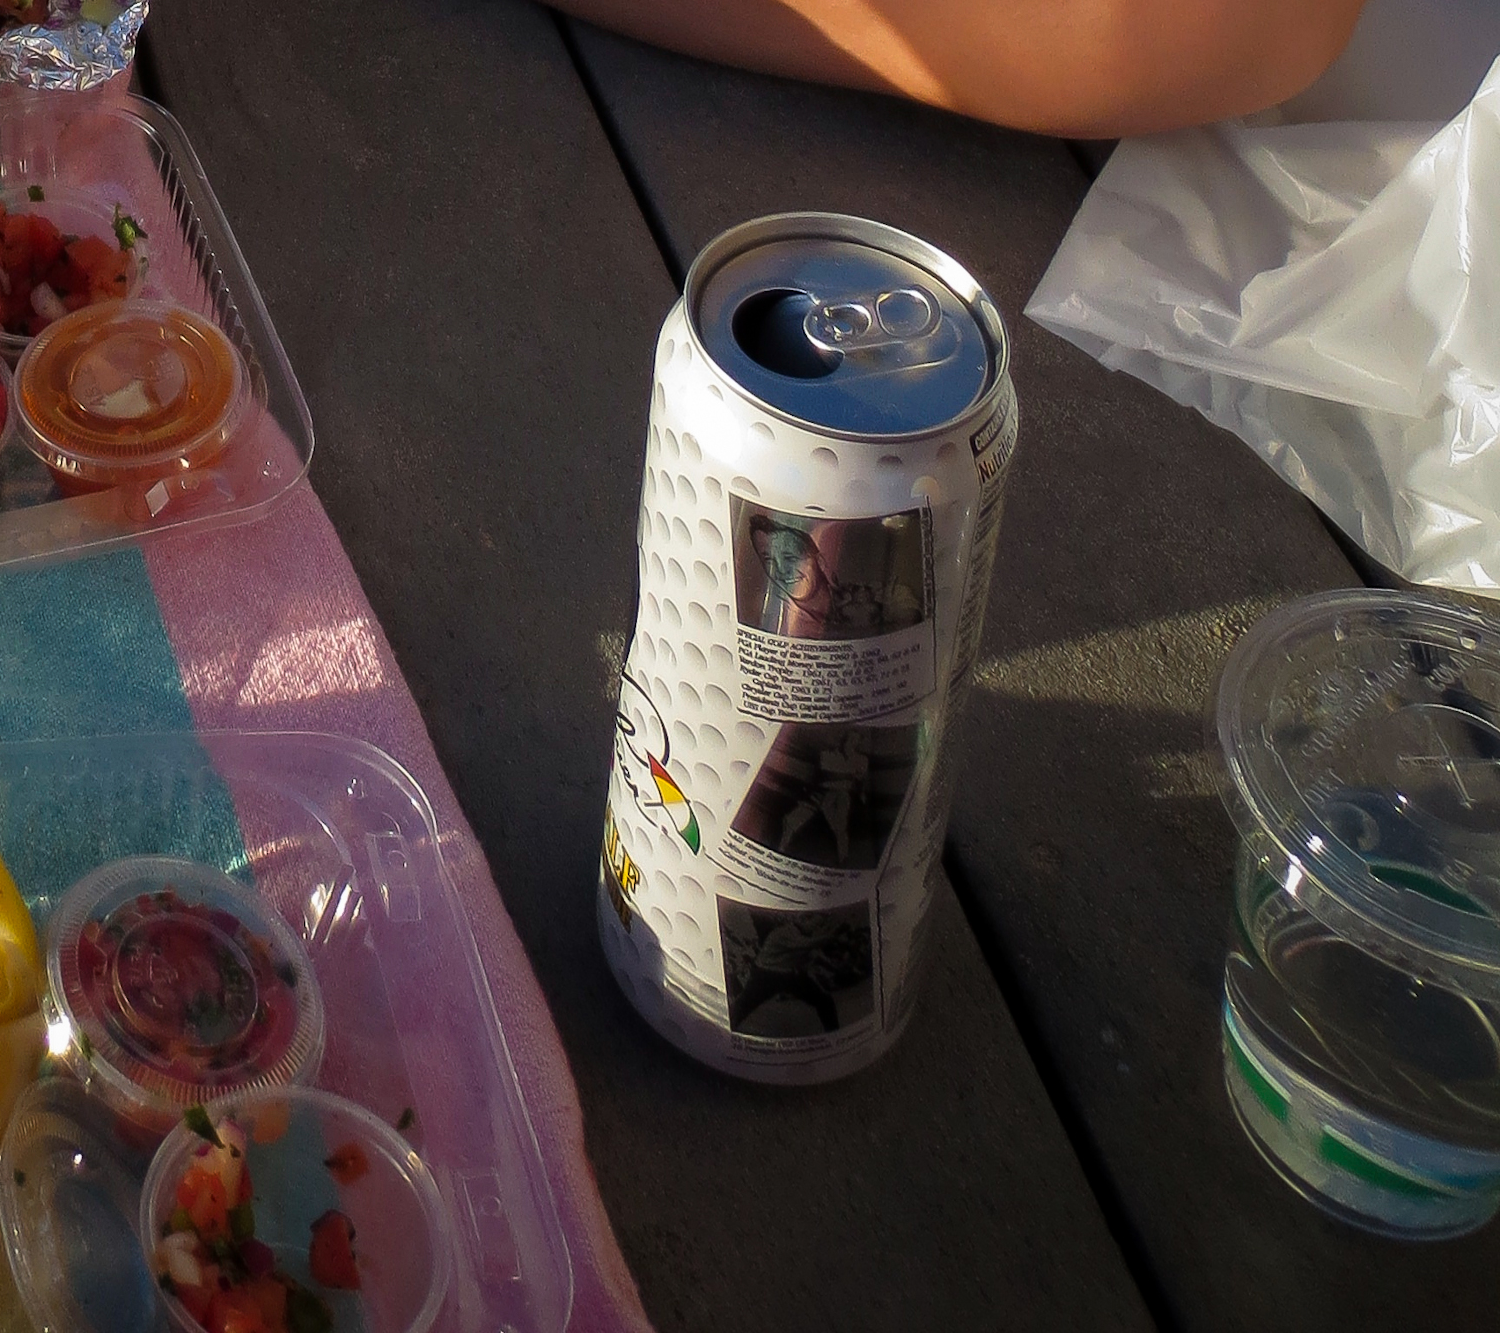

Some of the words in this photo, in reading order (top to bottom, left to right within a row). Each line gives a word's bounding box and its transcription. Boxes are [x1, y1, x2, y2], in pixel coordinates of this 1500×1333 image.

[738, 637, 752, 648] PGA
[754, 643, 779, 655] Player
[779, 650, 788, 658] of
[738, 646, 753, 658] PGA
